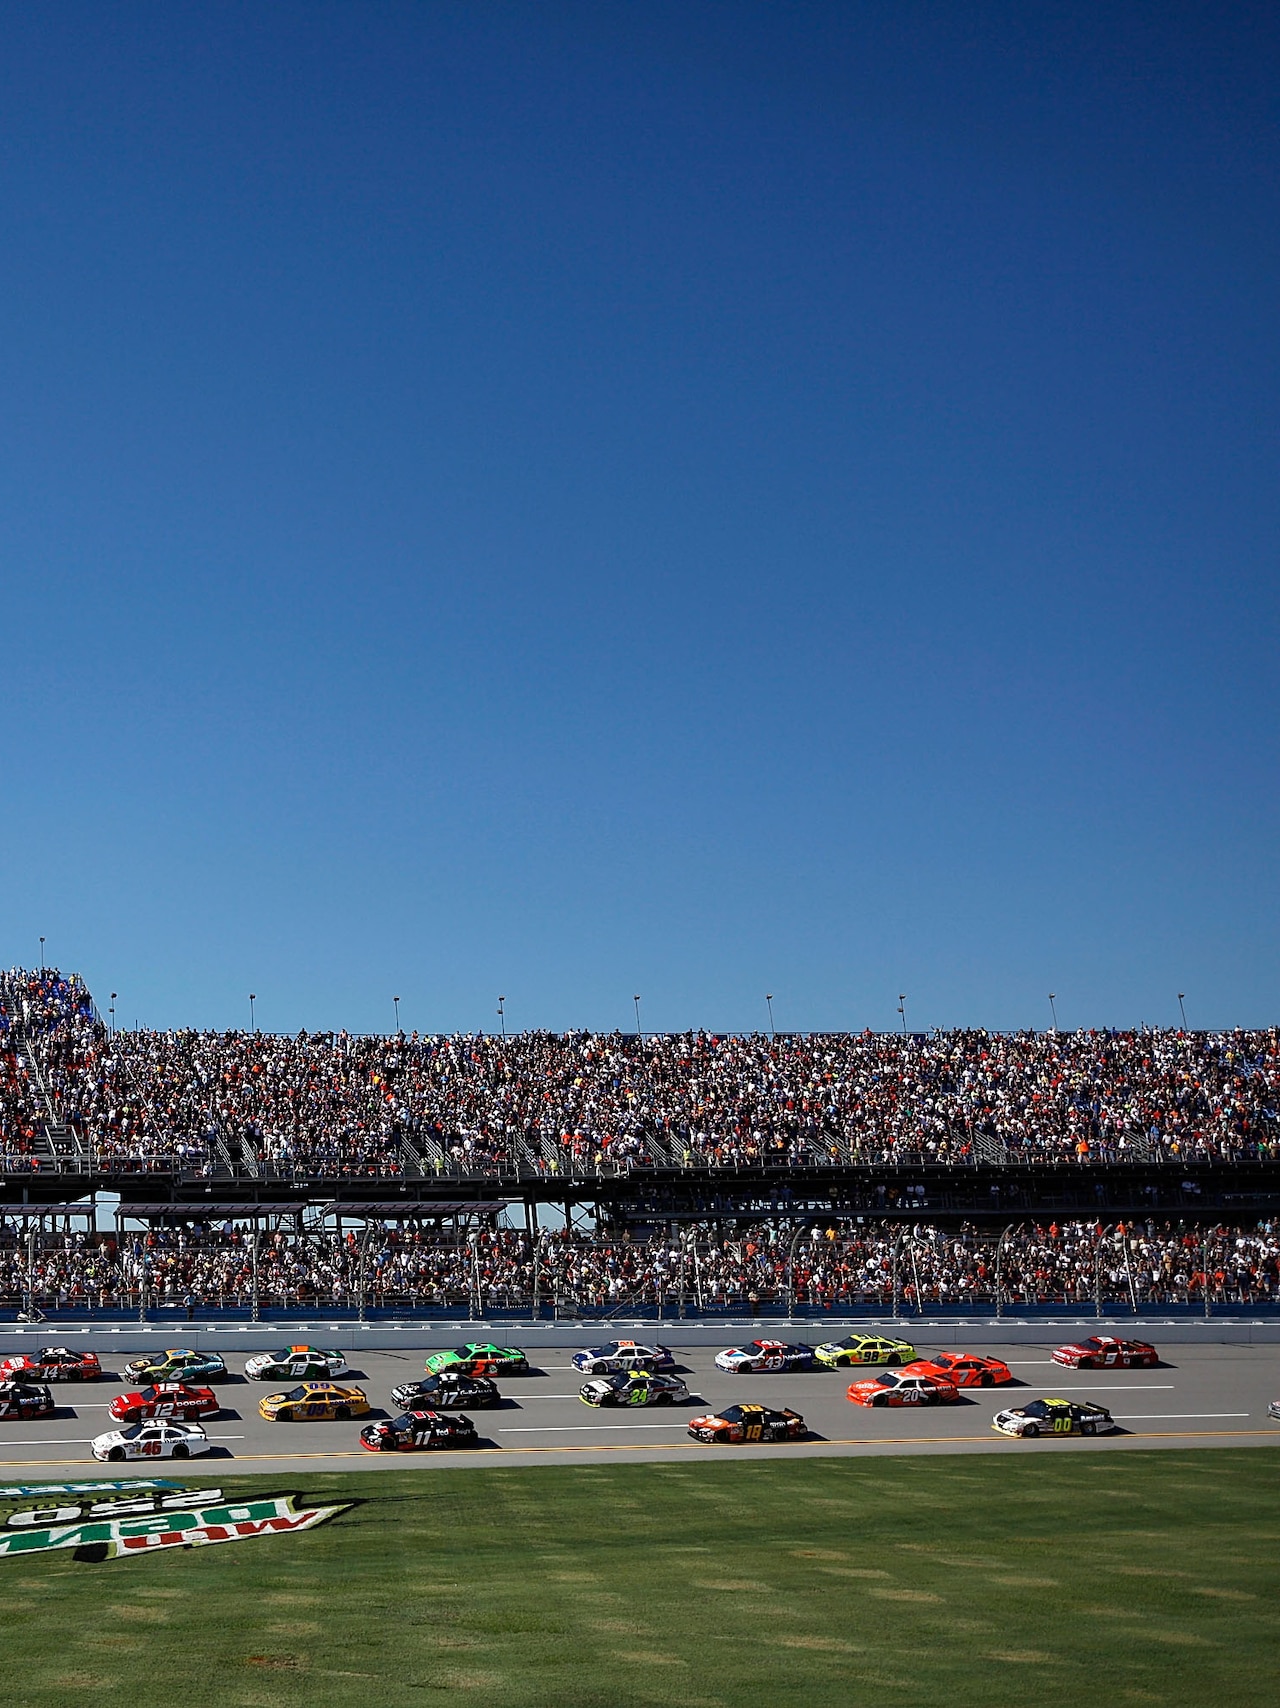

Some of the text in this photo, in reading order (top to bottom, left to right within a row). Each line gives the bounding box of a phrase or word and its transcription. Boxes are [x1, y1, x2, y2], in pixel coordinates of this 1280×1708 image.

[765, 1356, 782, 1368] 43
[864, 1351, 879, 1362] 98
[1104, 1353, 1117, 1364] 9
[41, 1366, 58, 1378] 14
[168, 1369, 183, 1380] 6
[290, 1363, 308, 1376] 19
[472, 1361, 485, 1375] 5
[958, 1371, 969, 1382] 7
[158, 1383, 180, 1391] 12
[441, 1392, 458, 1405] 17
[631, 1389, 648, 1403] 24
[903, 1390, 918, 1402] 20
[154, 1403, 174, 1416] 12
[412, 1410, 438, 1419] 11
[1054, 1417, 1072, 1432] 00
[415, 1431, 431, 1445] 11
[746, 1425, 762, 1439] 18
[142, 1441, 162, 1455] 46
[7, 1489, 223, 1526] 250
